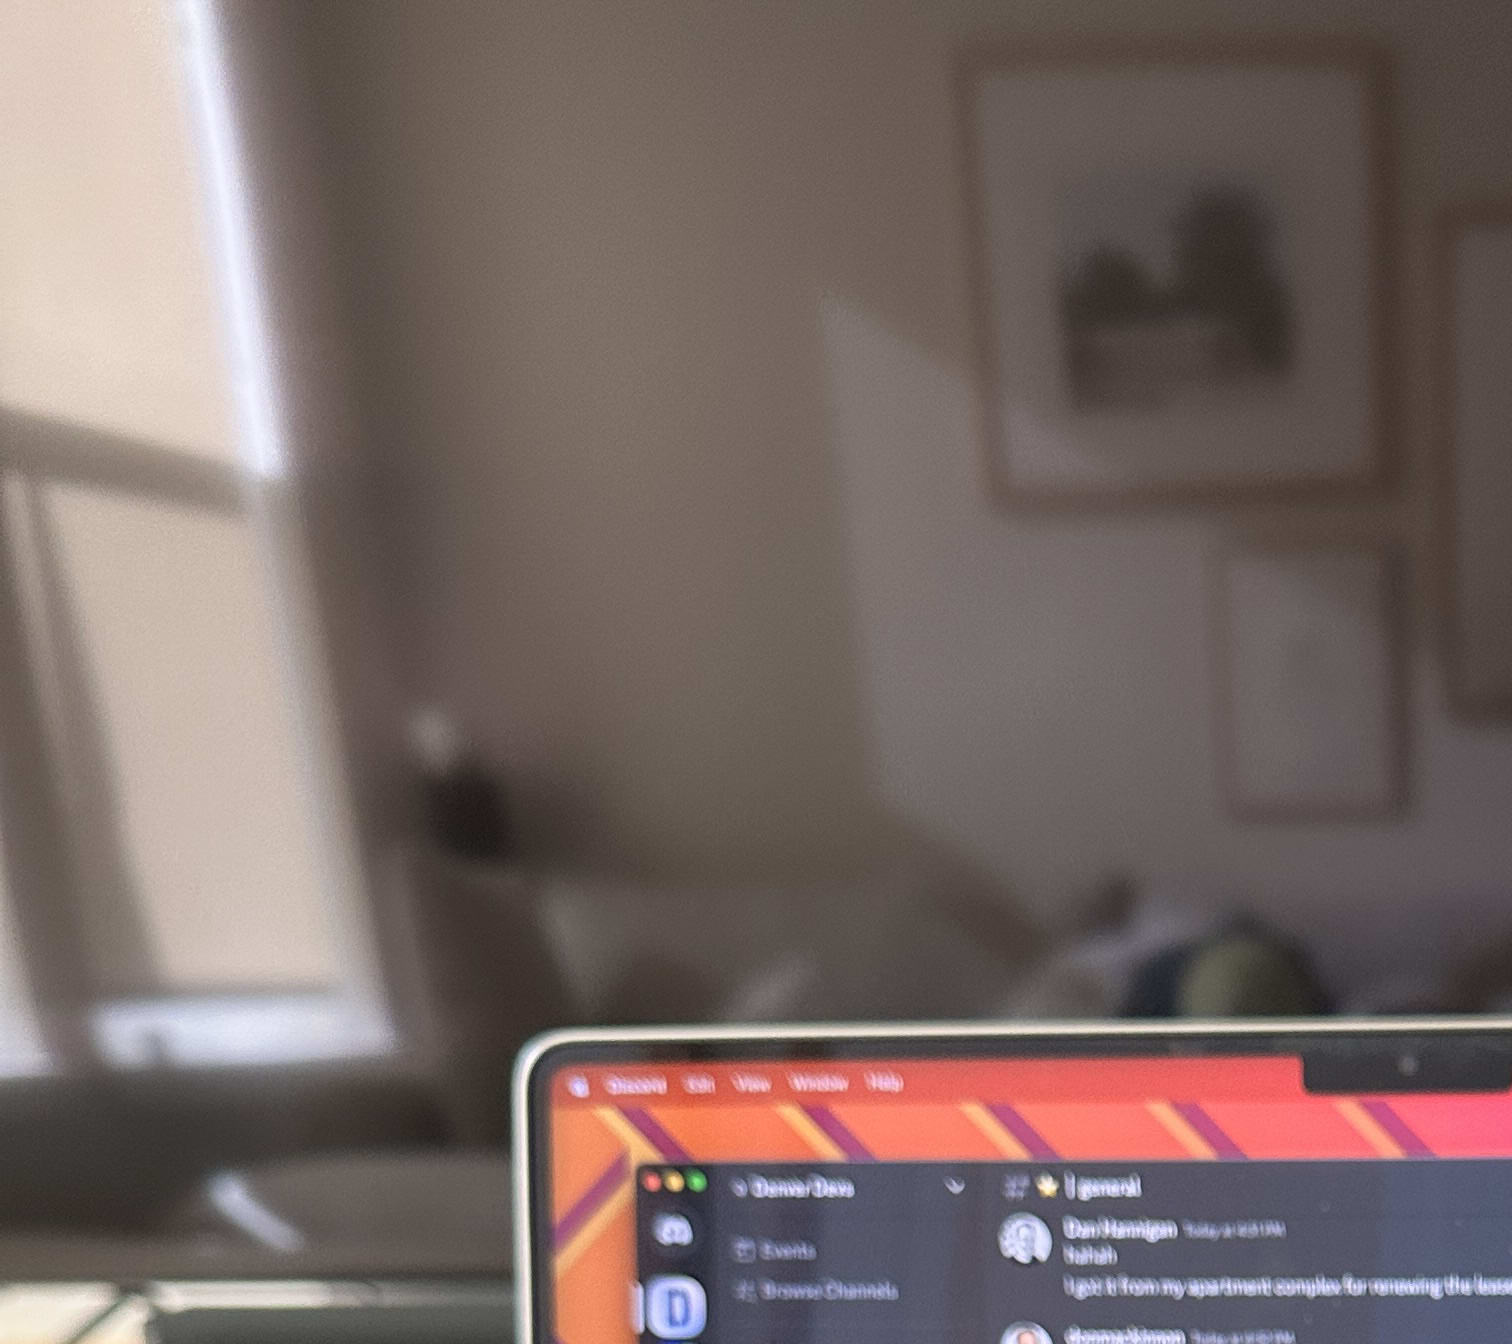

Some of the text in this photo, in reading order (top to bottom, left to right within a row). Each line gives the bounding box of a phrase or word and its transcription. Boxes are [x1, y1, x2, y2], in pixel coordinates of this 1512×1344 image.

[730, 1072, 772, 1093] View
[786, 1071, 849, 1092] Window
[1077, 1172, 1142, 1200] general
[1062, 1217, 1099, 1239] Dan
[759, 1241, 817, 1260] Events
[1073, 1276, 1102, 1299] got
[1117, 1274, 1159, 1296] from
[1160, 1278, 1184, 1299] my
[1186, 1275, 1271, 1299] apartment
[1273, 1274, 1341, 1299] complex
[1342, 1273, 1367, 1296] for
[1369, 1273, 1442, 1298] renewing
[1444, 1273, 1471, 1294] the
